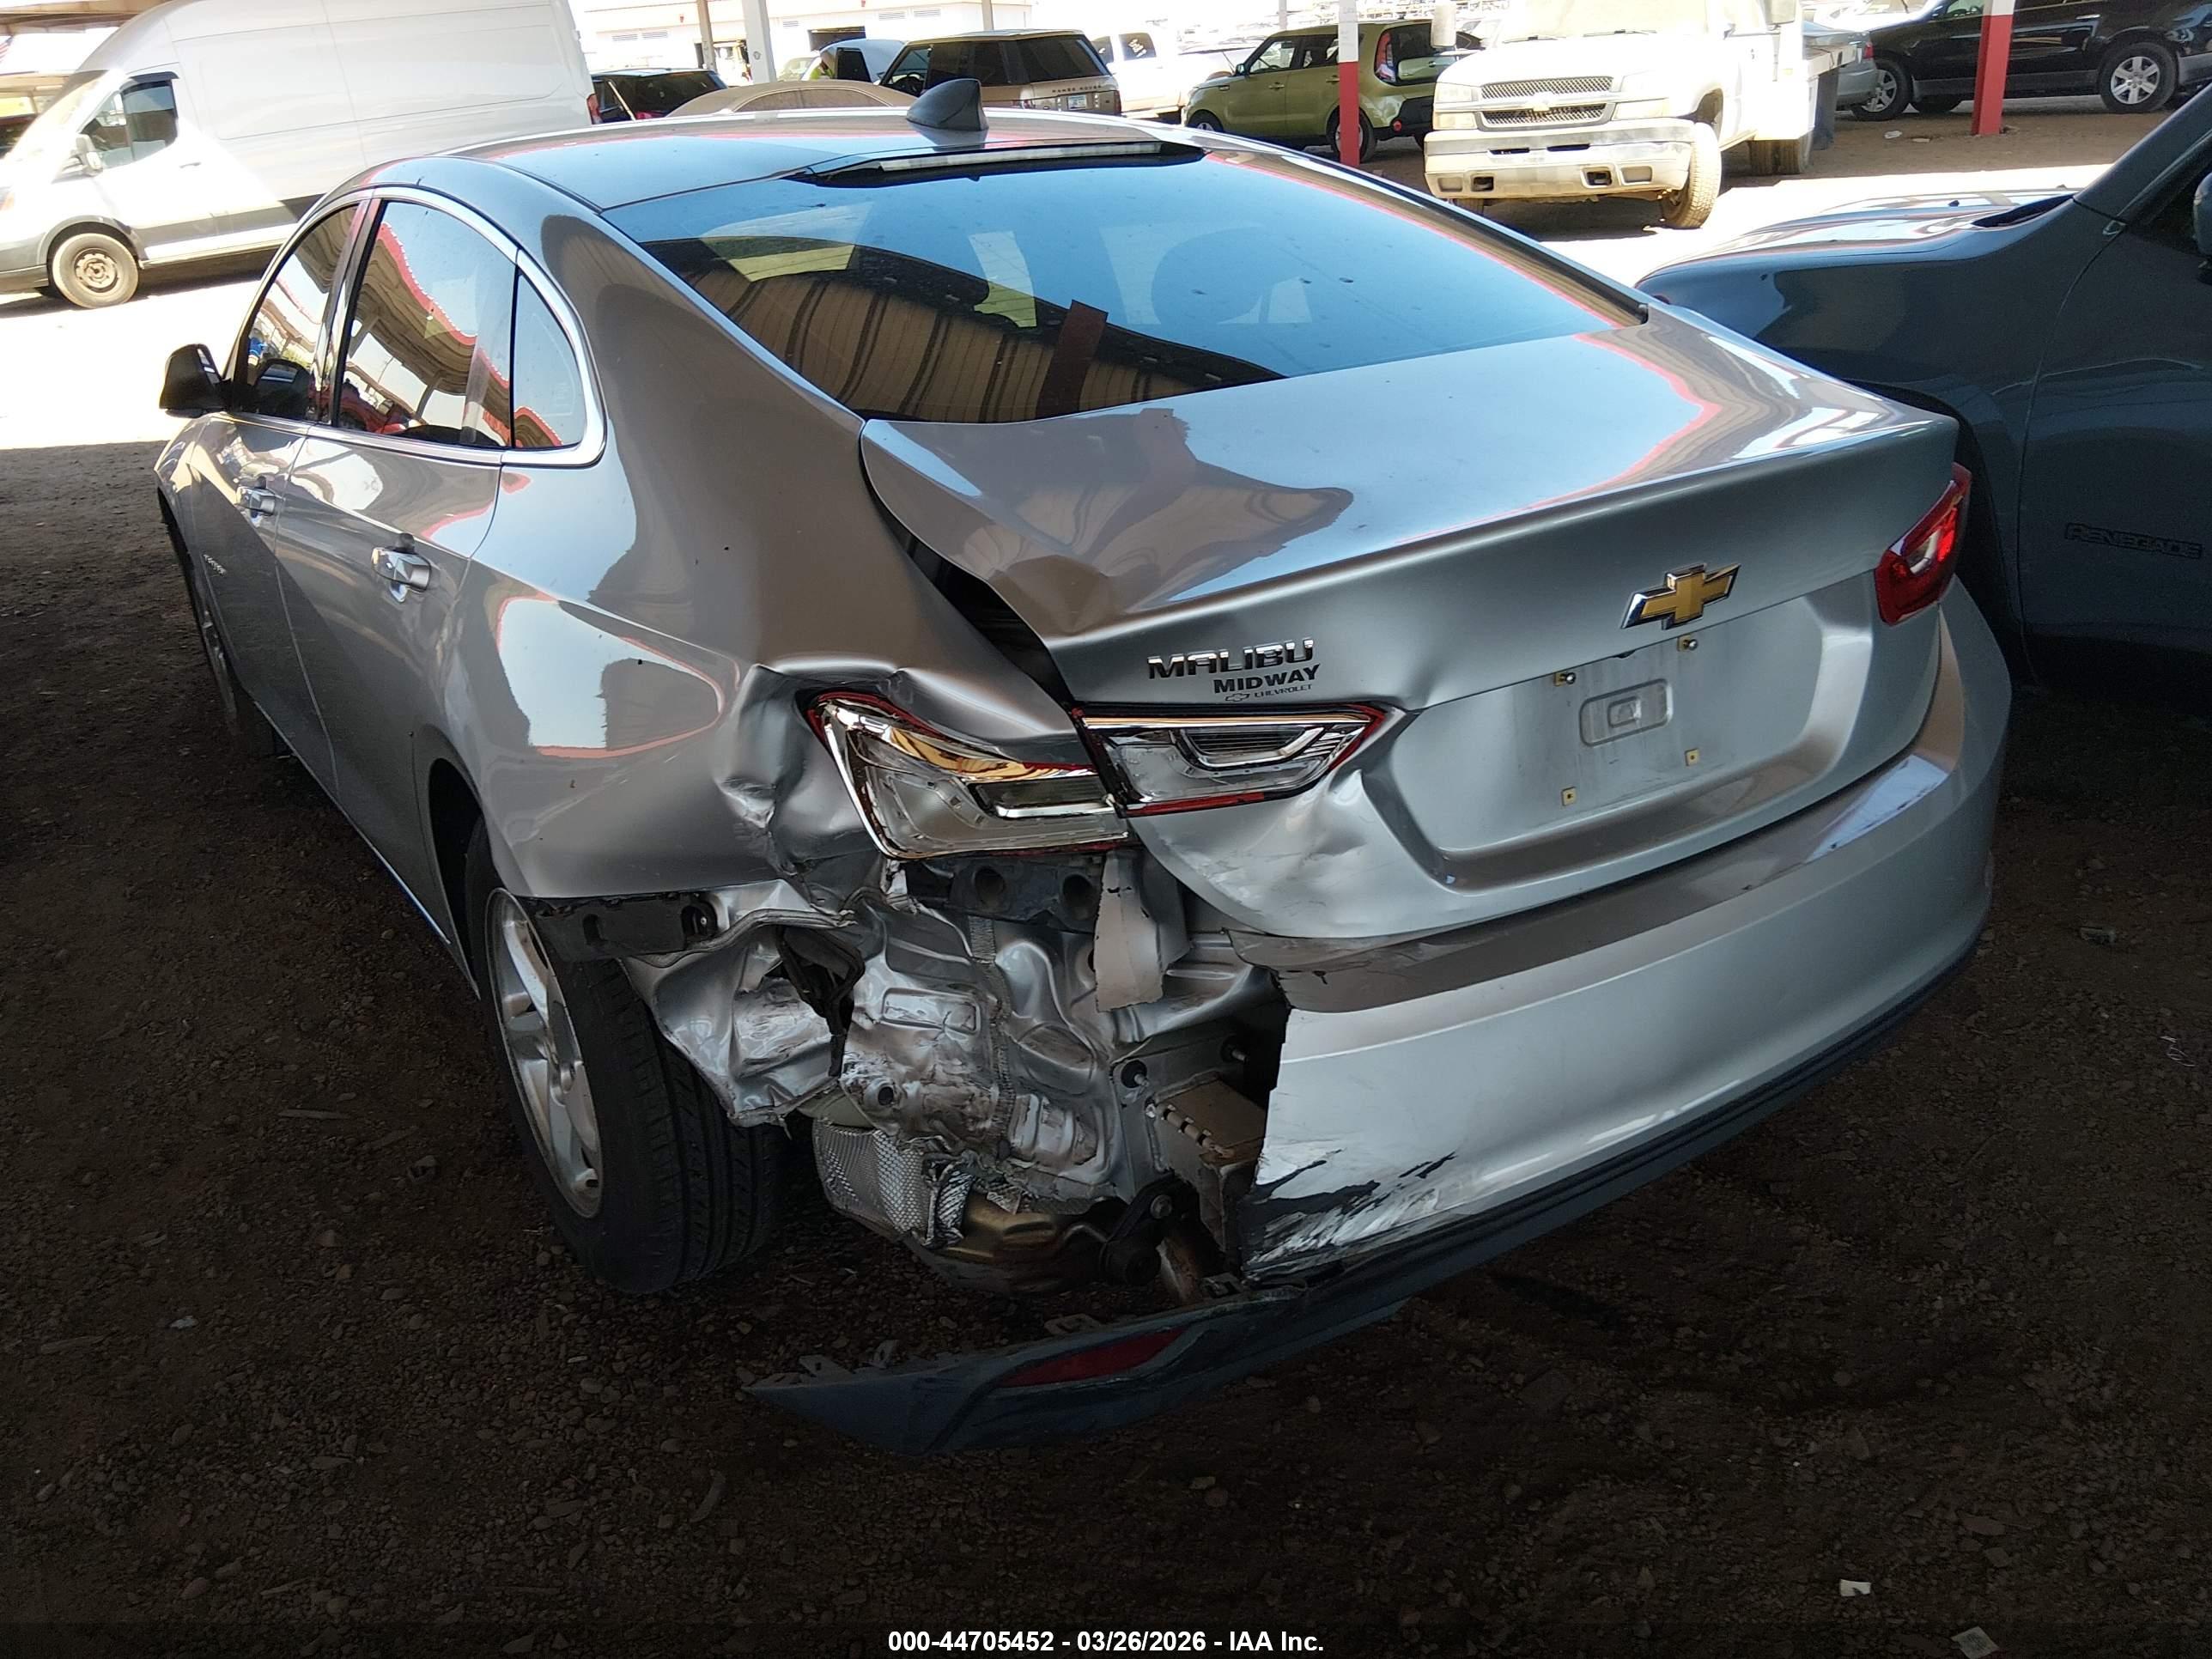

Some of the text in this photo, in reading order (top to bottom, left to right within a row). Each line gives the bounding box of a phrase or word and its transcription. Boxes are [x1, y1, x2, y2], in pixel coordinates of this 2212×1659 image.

[1147, 638, 1314, 679] MALIBU
[1213, 664, 1321, 694] MIDWAY
[1255, 684, 1313, 698] CHEVROLET
